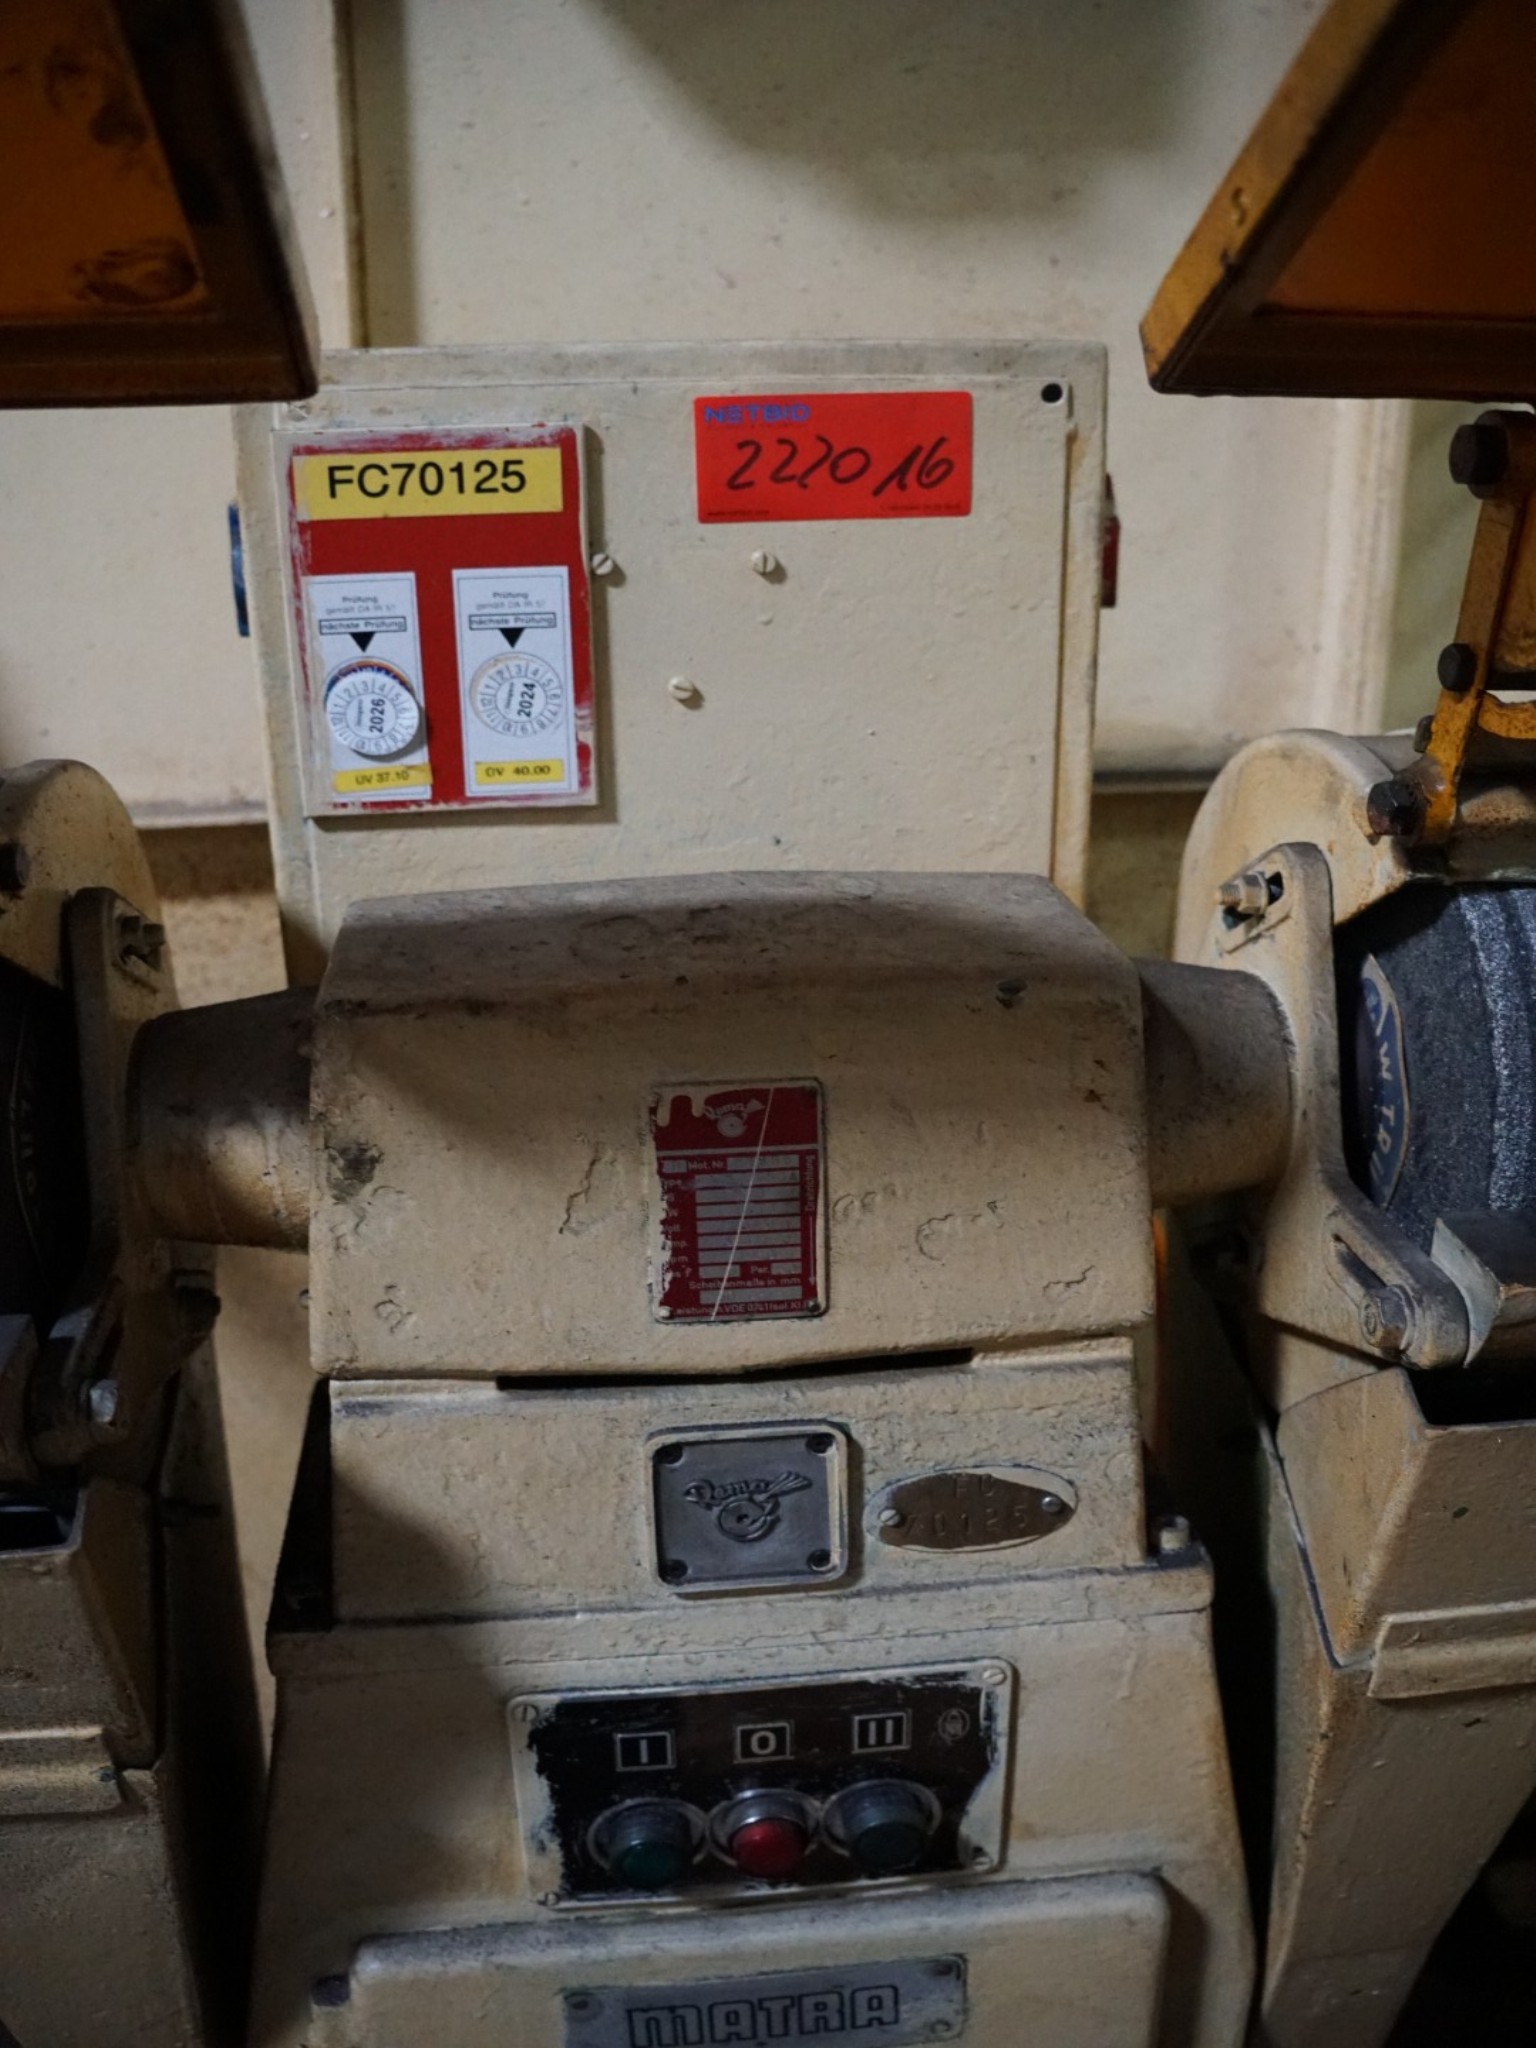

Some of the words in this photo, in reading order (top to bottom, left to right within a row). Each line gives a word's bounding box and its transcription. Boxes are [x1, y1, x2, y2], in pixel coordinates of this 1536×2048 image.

[704, 403, 810, 424] NETBID
[327, 459, 528, 499] FC70125
[364, 620, 405, 632] Prüfung
[514, 616, 554, 628] Prüfung
[369, 698, 386, 734] 2026
[517, 682, 537, 718] 2024
[904, 1505, 1029, 1537] 70125
[626, 1984, 900, 2048] MATRA
